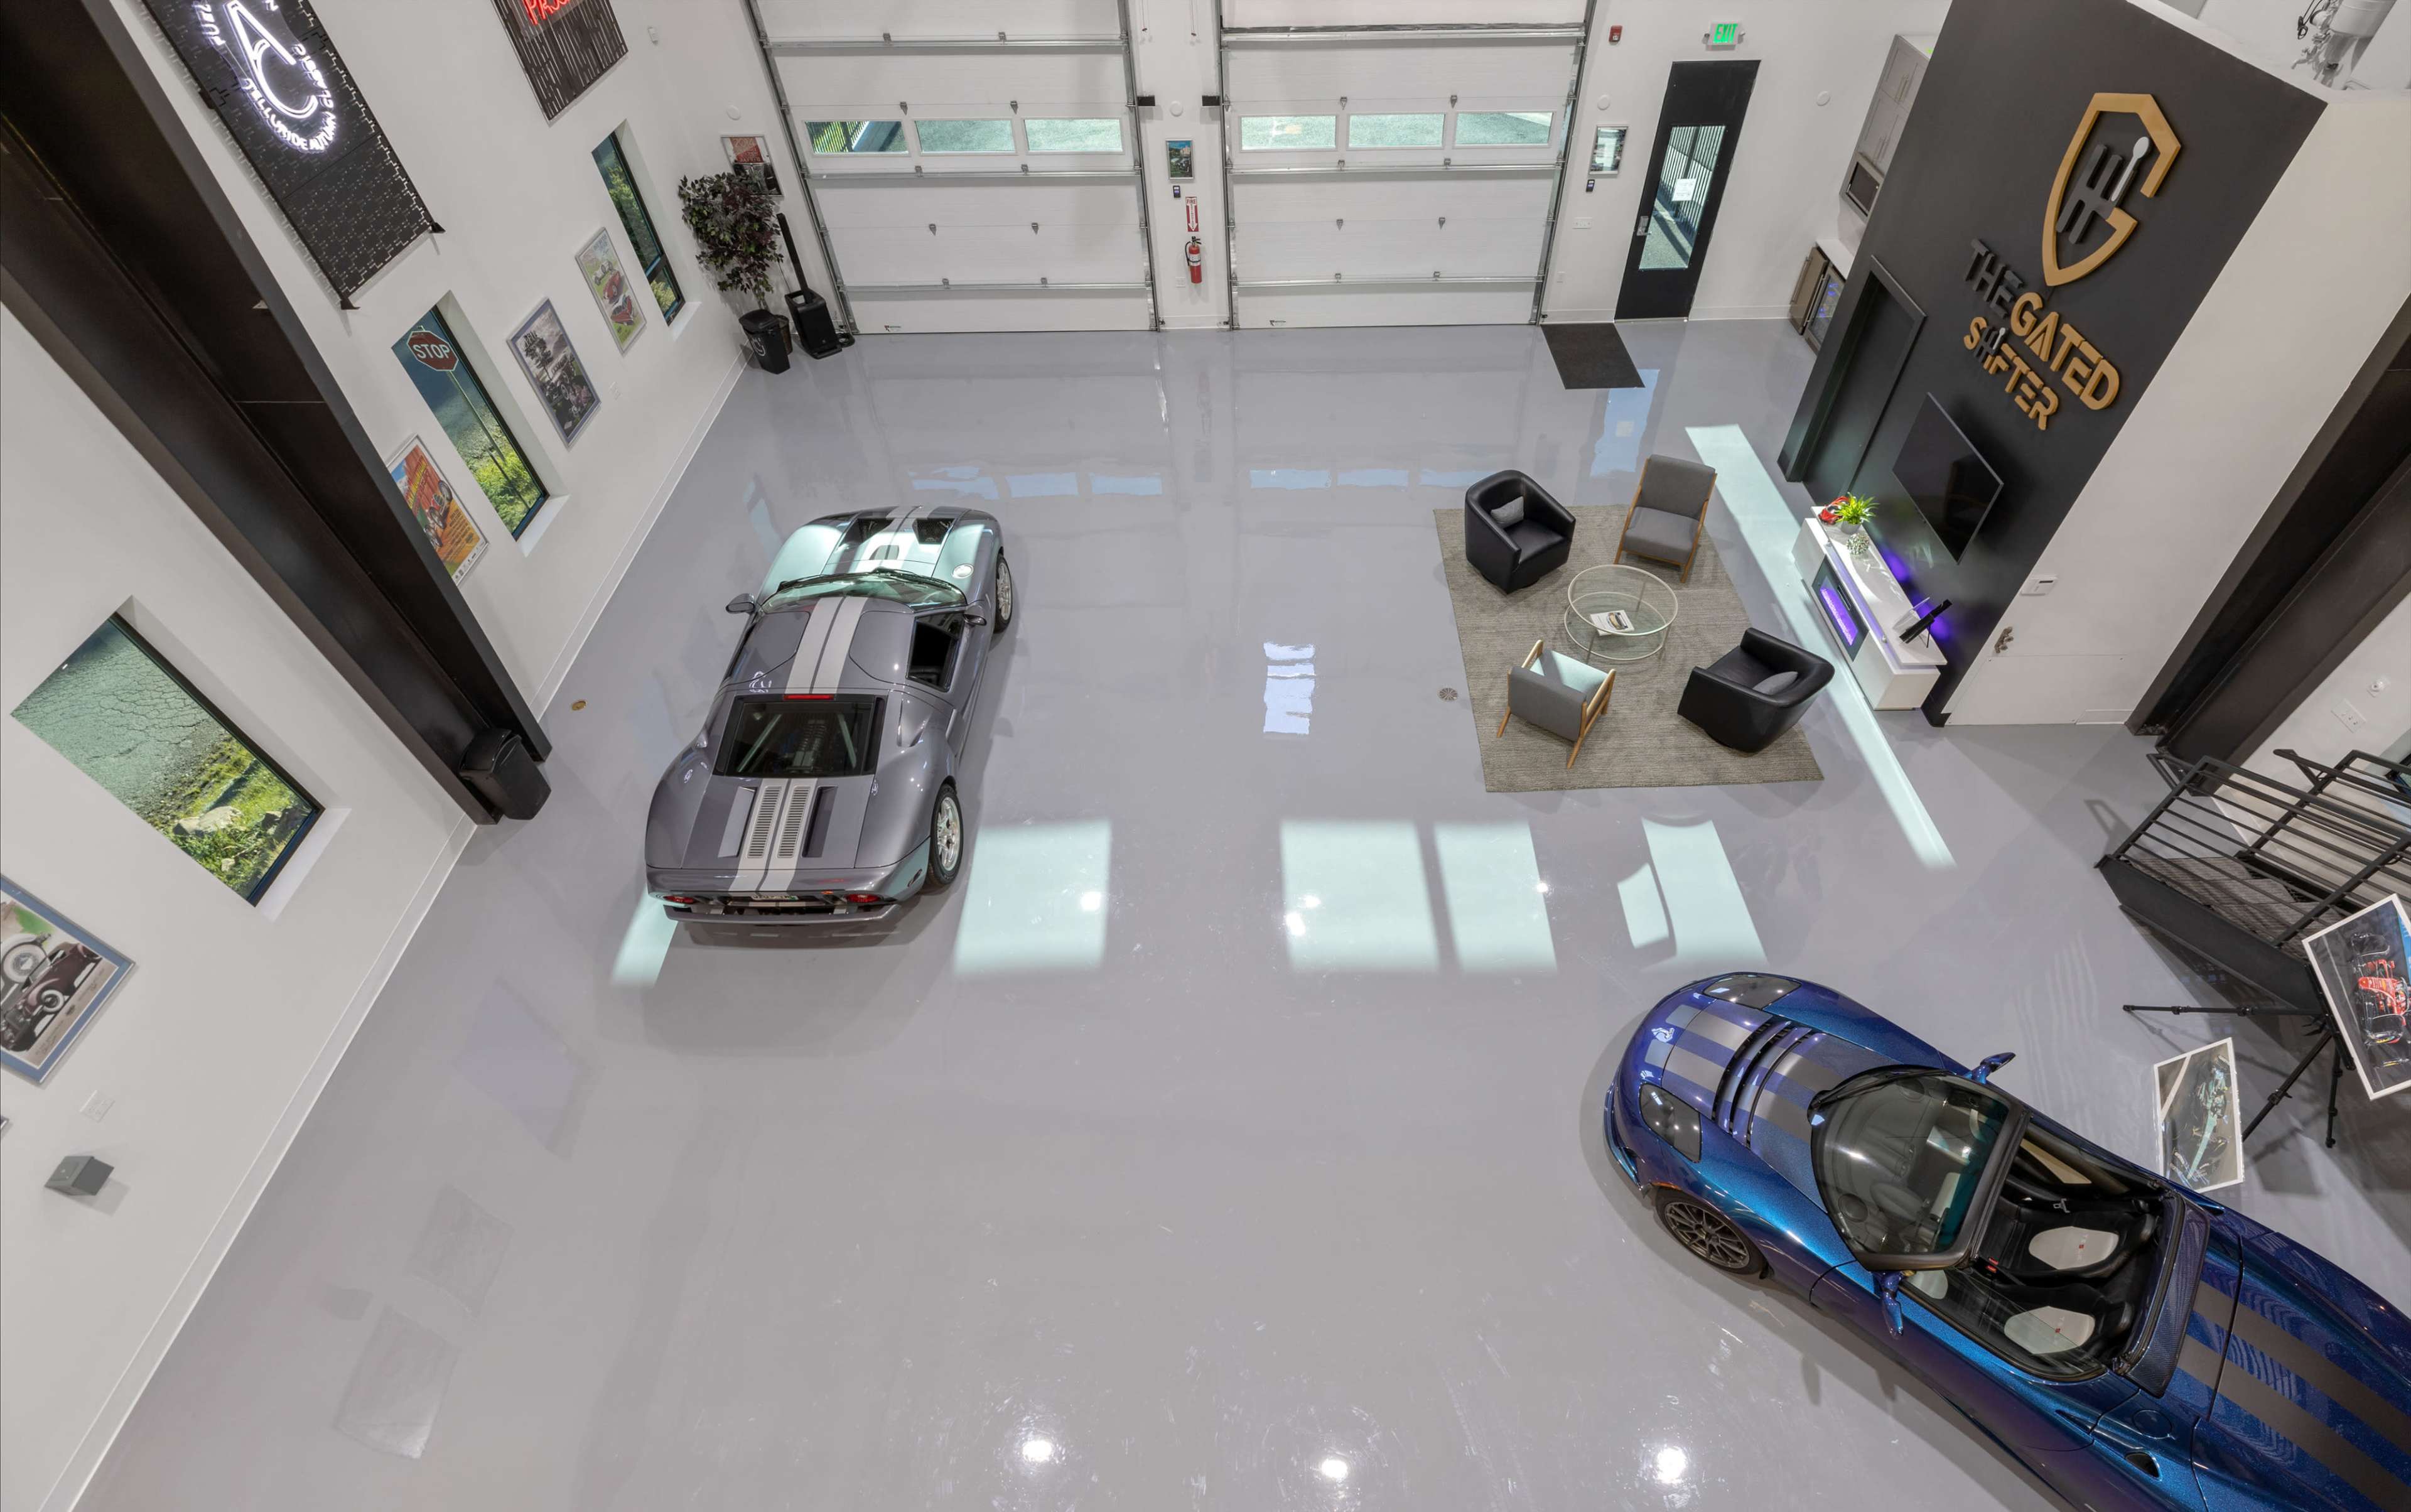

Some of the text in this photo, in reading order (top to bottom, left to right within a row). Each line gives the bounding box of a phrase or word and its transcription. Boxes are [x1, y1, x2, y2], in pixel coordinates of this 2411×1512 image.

[1713, 23, 1739, 43] EXIT
[1965, 238, 2120, 411] THE GATED
[413, 343, 451, 359] STOP
